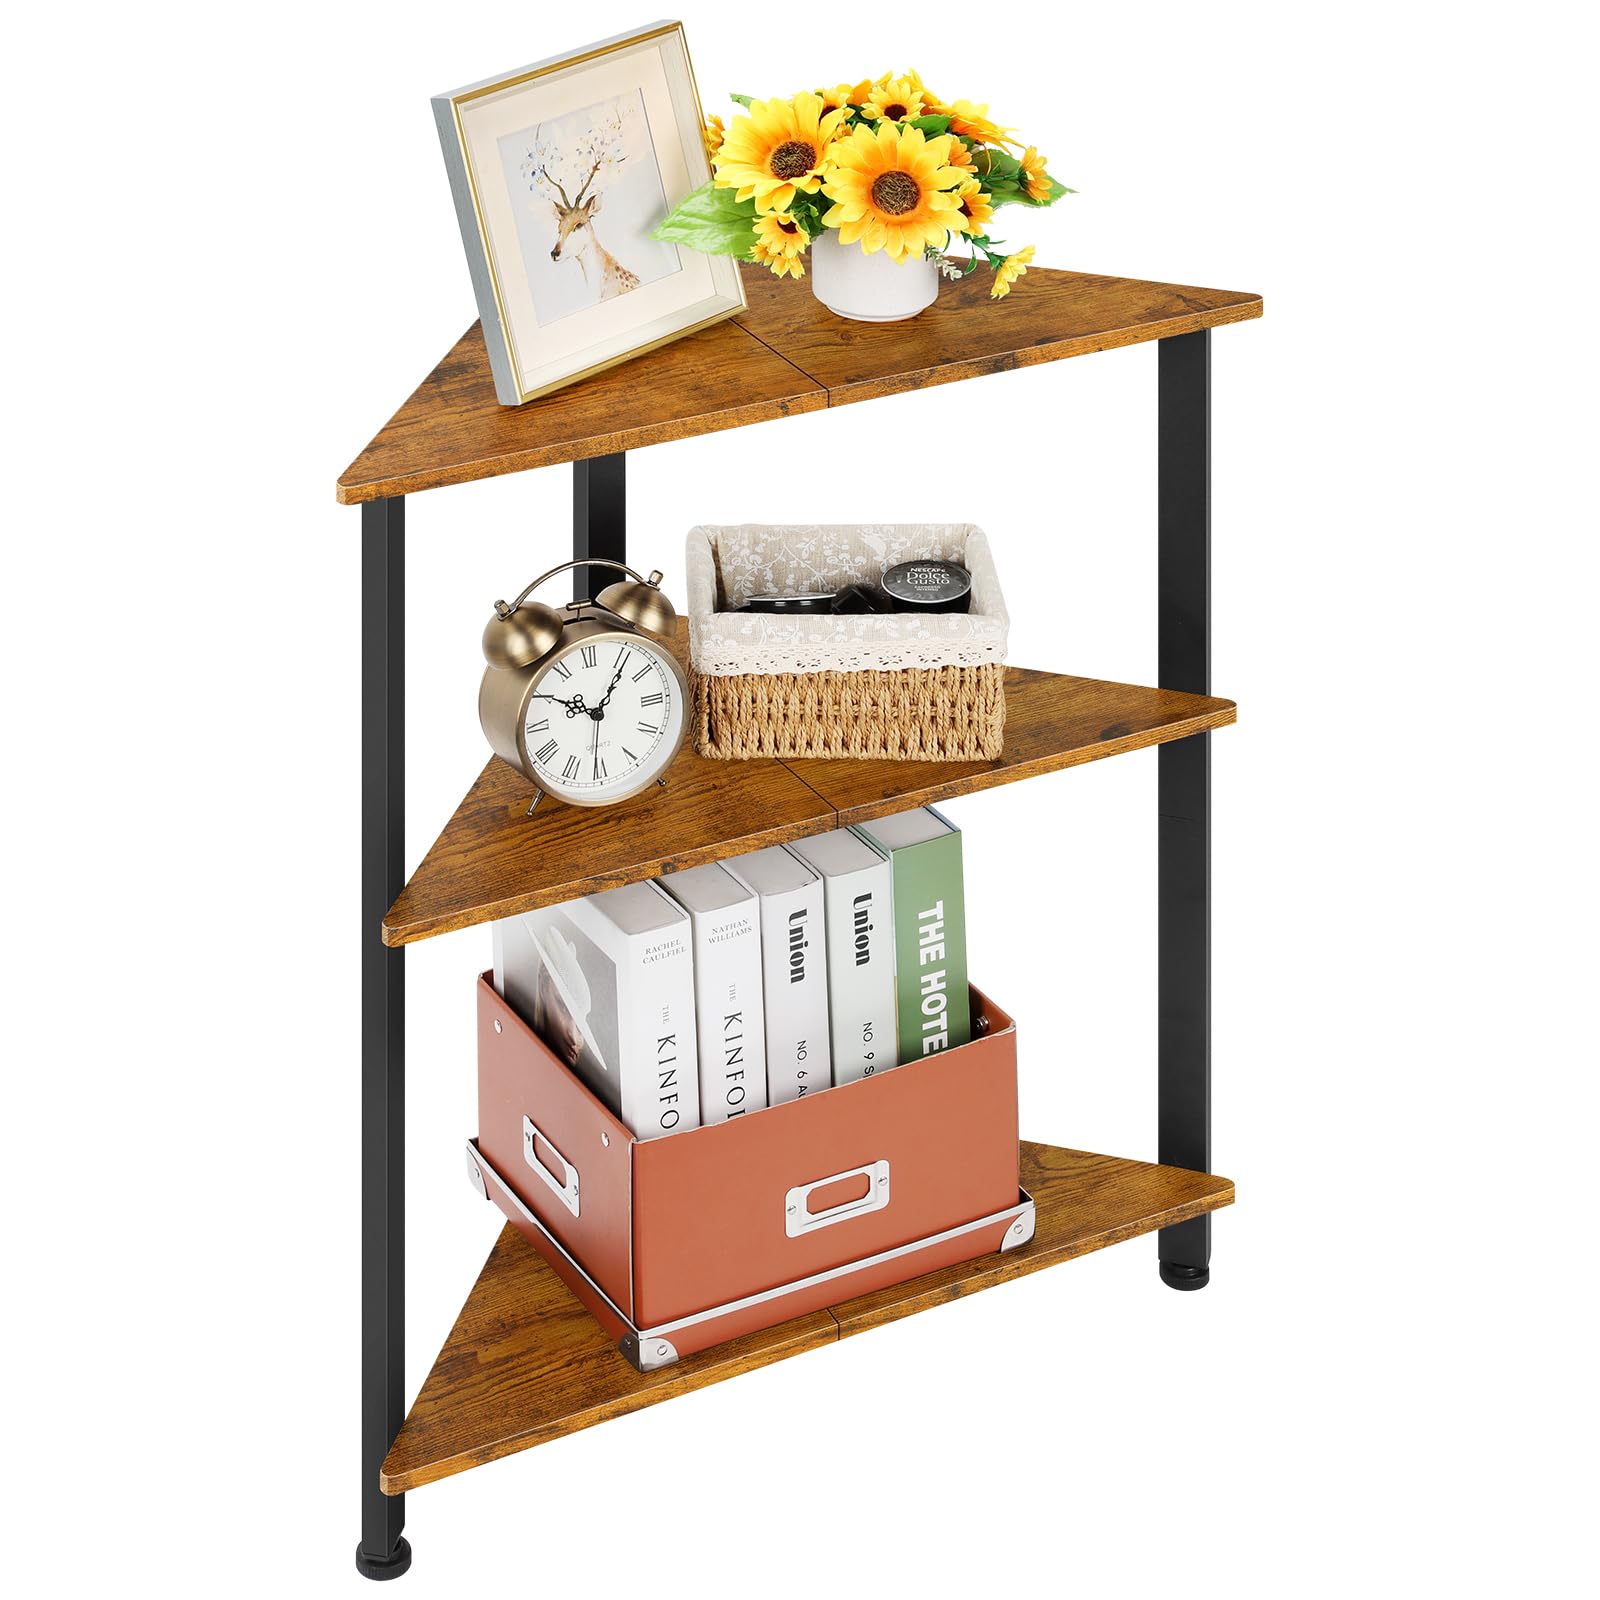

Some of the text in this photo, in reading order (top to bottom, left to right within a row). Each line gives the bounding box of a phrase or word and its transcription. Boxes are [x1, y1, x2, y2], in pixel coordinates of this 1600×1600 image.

[907, 571, 950, 580] Dolce
[640, 692, 663, 708] III
[708, 925, 753, 944] WILLIAMS
[711, 918, 749, 935] NATHAN
[853, 892, 873, 967] Union
[645, 939, 681, 955] RACHEL
[788, 908, 808, 984] Union
[918, 900, 949, 1054] THE HOTE
[728, 983, 737, 1002] THE
[863, 1021, 874, 1046] NO.
[796, 1039, 808, 1065] NO.
[863, 1051, 875, 1060] 9
[657, 1004, 680, 1129] THE KINFO
[796, 1070, 808, 1079] 6
